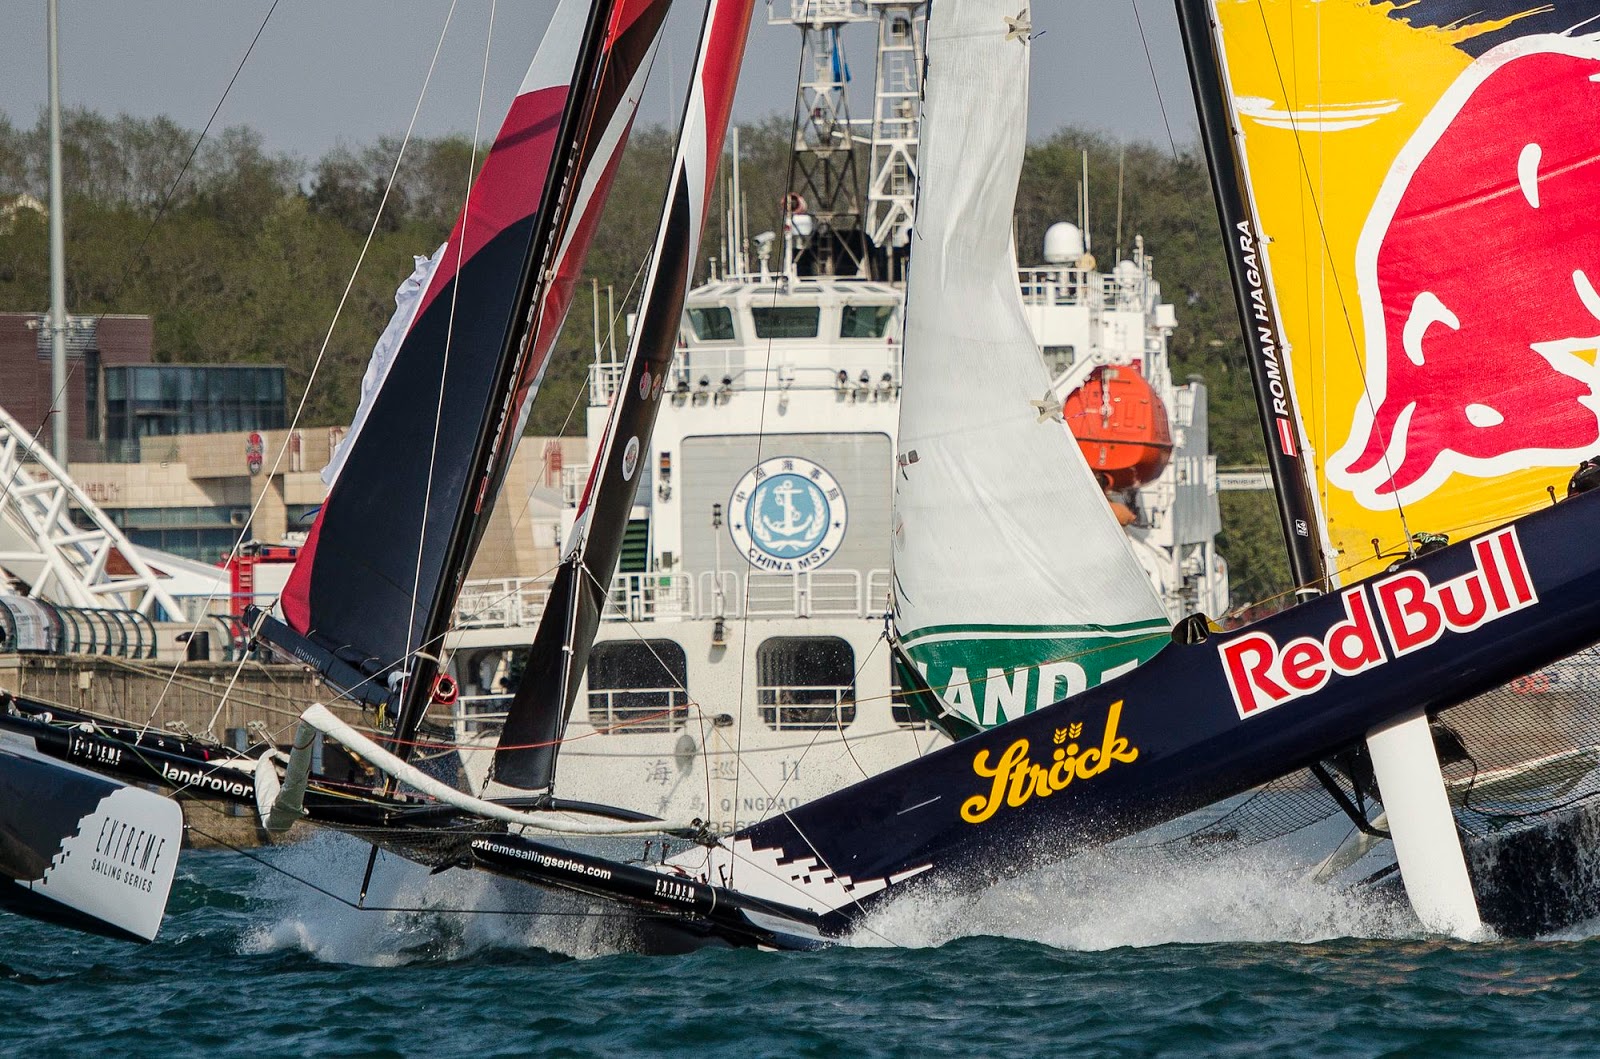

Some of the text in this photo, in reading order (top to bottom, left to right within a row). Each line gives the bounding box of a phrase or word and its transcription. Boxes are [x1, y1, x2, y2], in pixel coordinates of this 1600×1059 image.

[1237, 220, 1288, 416] ROMAN HAGARA
[748, 547, 831, 570] CHINA MSA
[1220, 528, 1536, 717] Red Bull
[960, 699, 1139, 825] Ströck
[96, 816, 165, 875] EXTREME
[471, 839, 612, 880] extremesailingseries.com
[91, 858, 153, 893] SAILING SERIES
